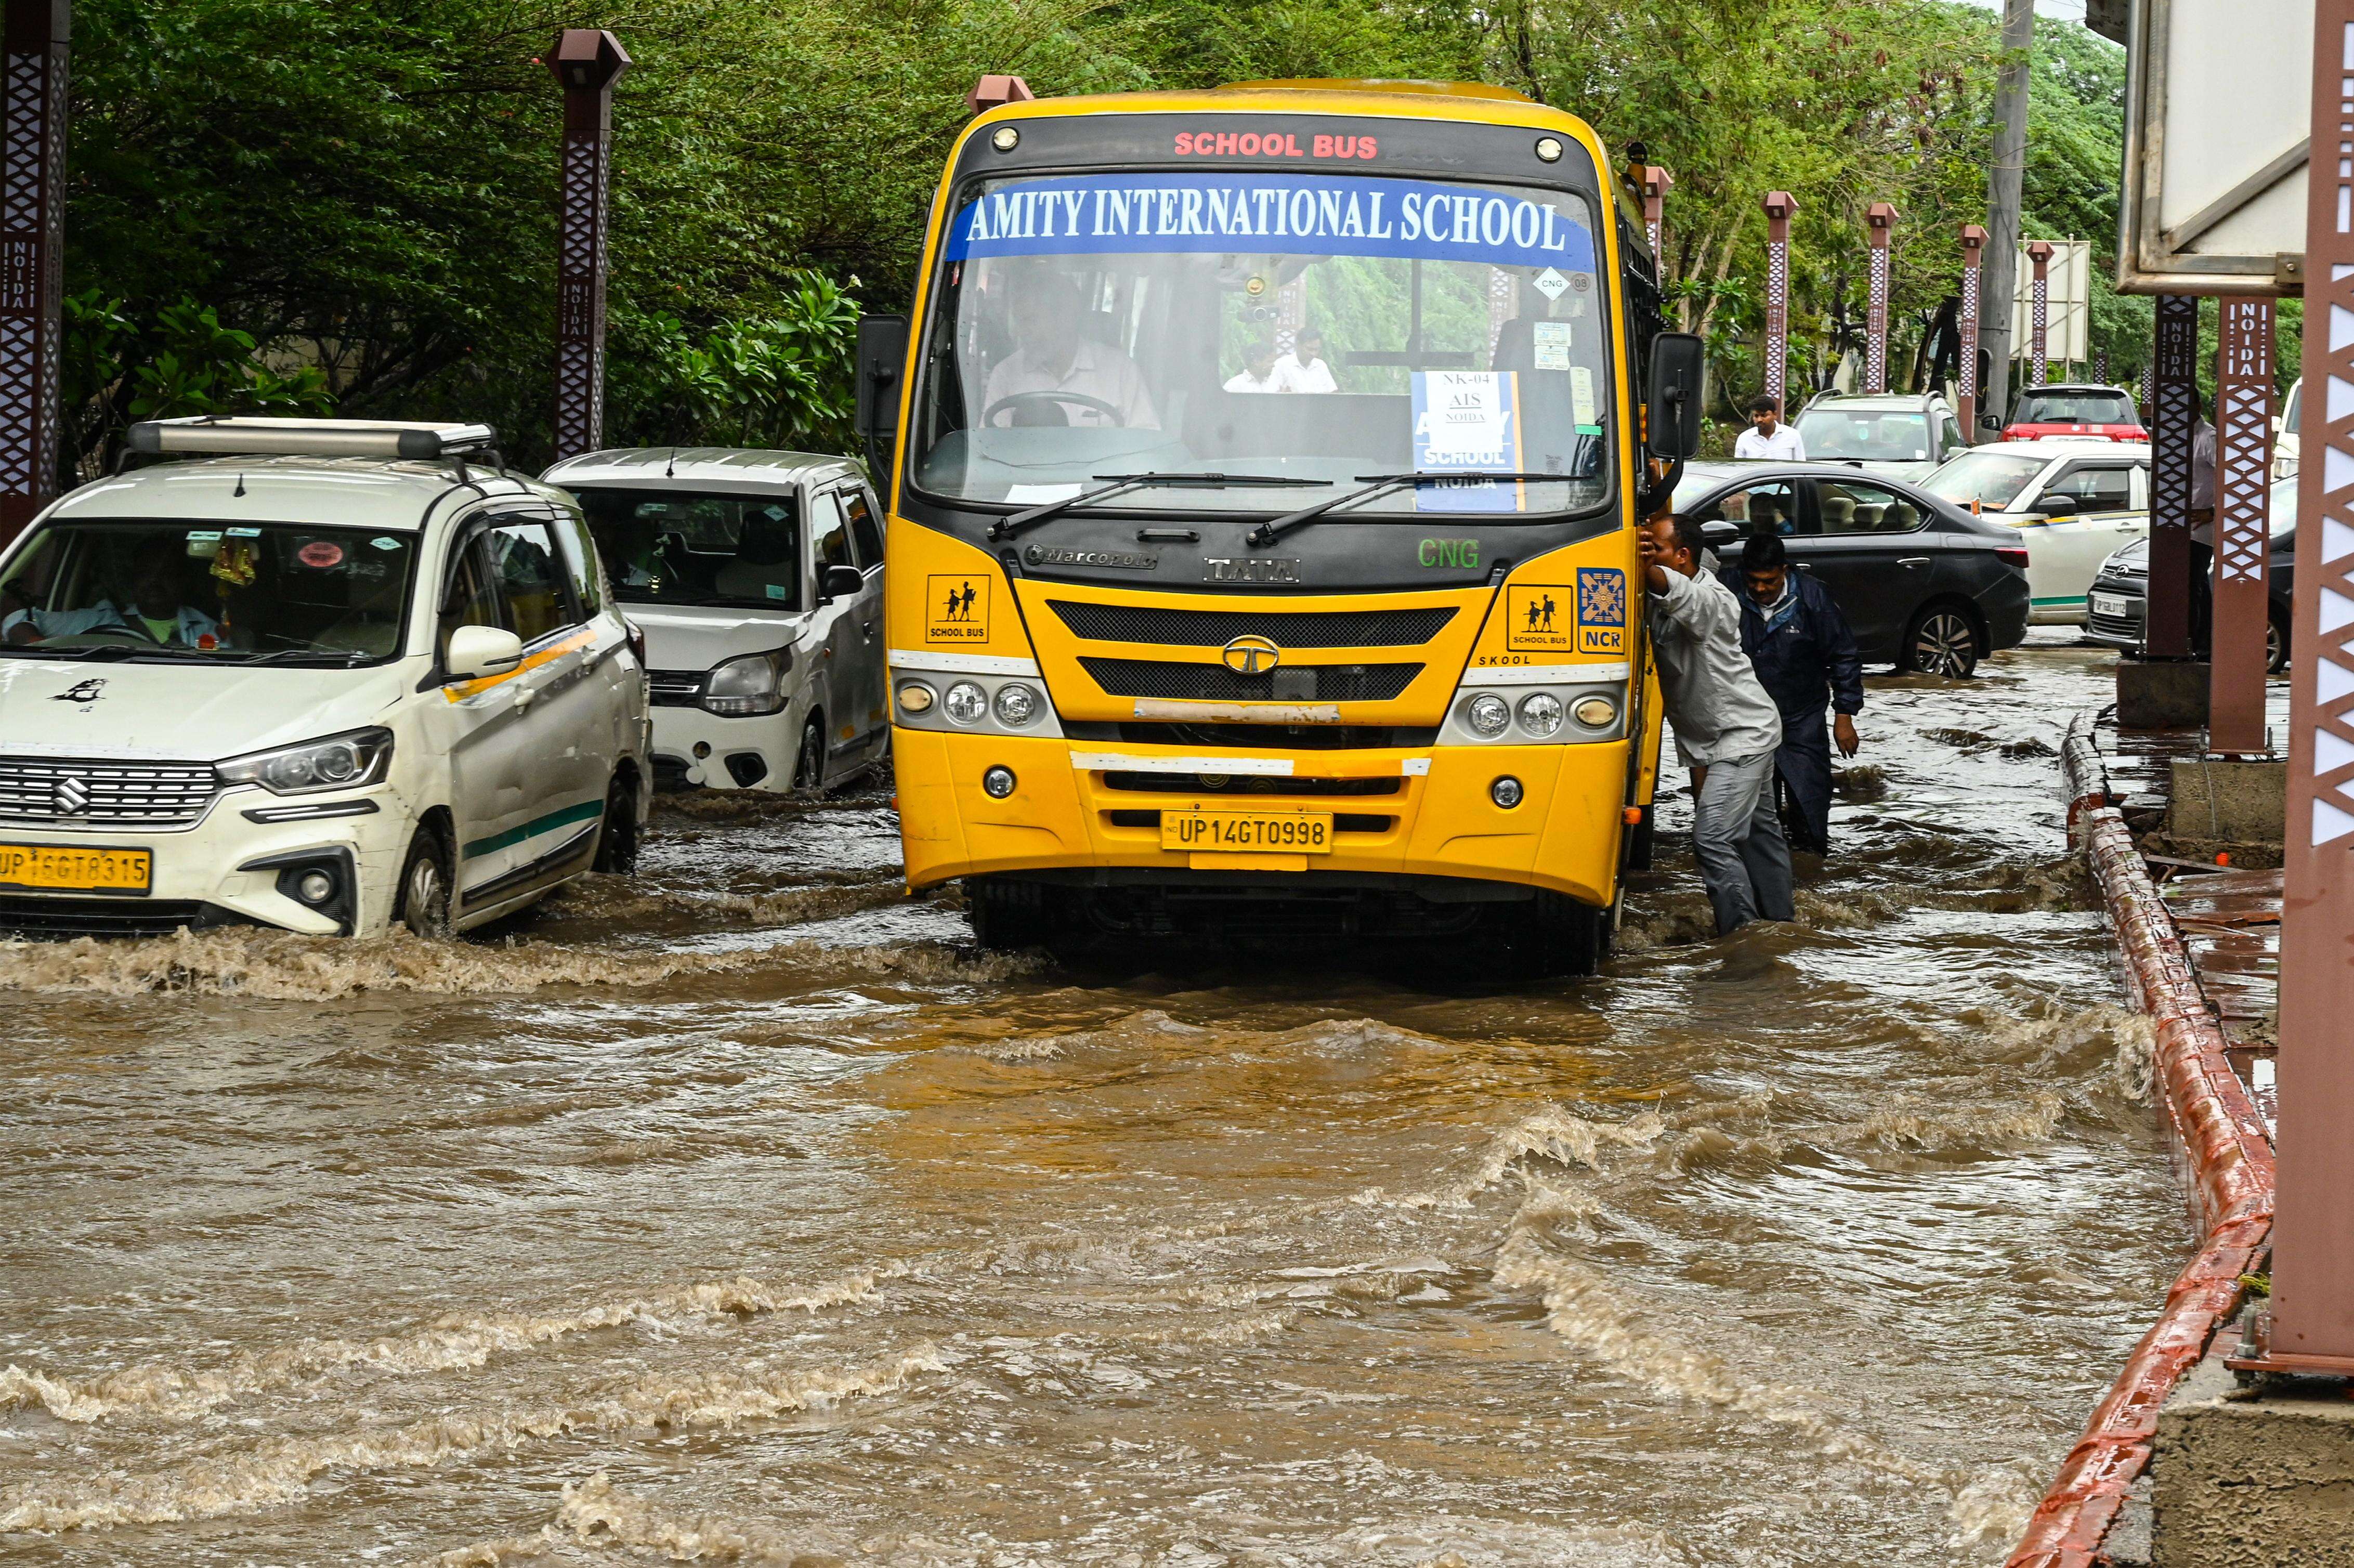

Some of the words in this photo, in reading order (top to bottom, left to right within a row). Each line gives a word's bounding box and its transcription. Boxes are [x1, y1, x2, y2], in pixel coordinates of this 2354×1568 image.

[1174, 132, 1303, 157] SCHOOL
[1313, 134, 1377, 160] BUS
[965, 190, 1089, 241] AMITY
[1091, 188, 1392, 239] INTERNATIONAL
[1401, 192, 1565, 251] SCHOOL
[12, 241, 26, 308] NOIDA
[1574, 279, 1587, 288] 08
[570, 284, 581, 335] NOIDA
[2170, 322, 2182, 376] NOIDA
[2240, 303, 2255, 376] NOIDA
[1443, 374, 1490, 385] NK-04
[1449, 393, 1481, 406] AIS
[1446, 413, 1486, 421] NOIDA
[1419, 539, 1480, 568] CNG
[1208, 558, 1294, 581] TATA
[931, 628, 964, 637] SCHOOL
[967, 628, 984, 637] BUS
[1586, 631, 1620, 647] NCR
[1479, 656, 1531, 665] SKOOL
[1180, 819, 1325, 845] UP14GT0998
